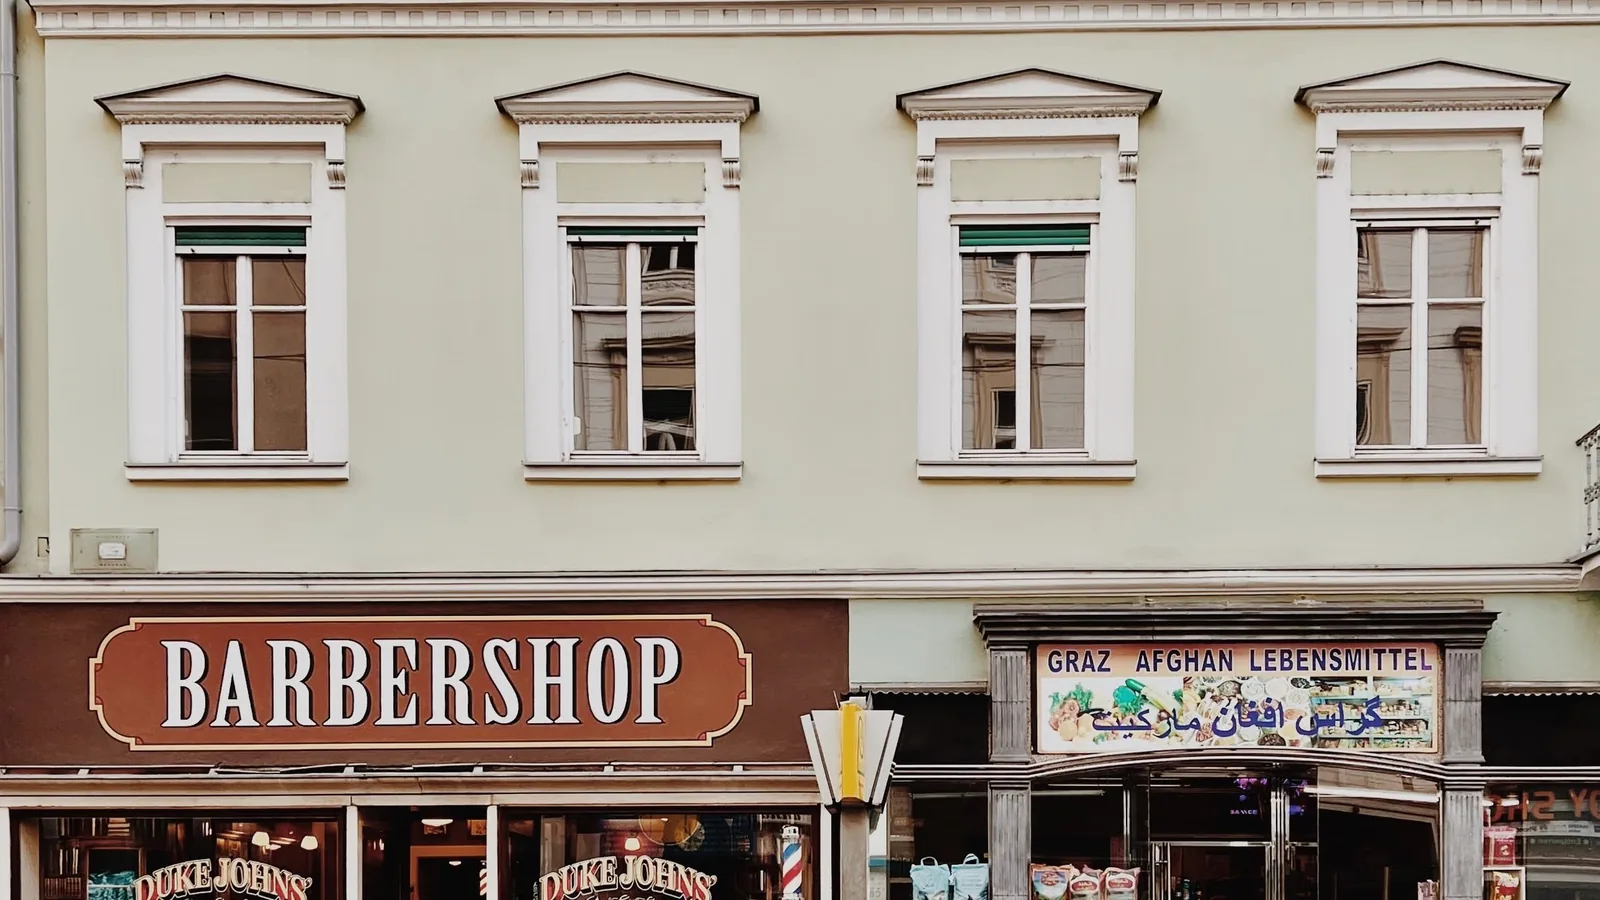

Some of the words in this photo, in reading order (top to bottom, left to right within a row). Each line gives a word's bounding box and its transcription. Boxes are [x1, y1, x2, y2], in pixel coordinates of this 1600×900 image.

[1047, 649, 1111, 673] GRAZ
[1135, 649, 1234, 672] AFGHAN
[1249, 648, 1433, 671] LEBENSMITTEL
[160, 636, 682, 729] BARBERSHOP
[1212, 697, 1284, 737] افغان
[134, 858, 212, 900] DUKE
[539, 856, 619, 900] DUKE
